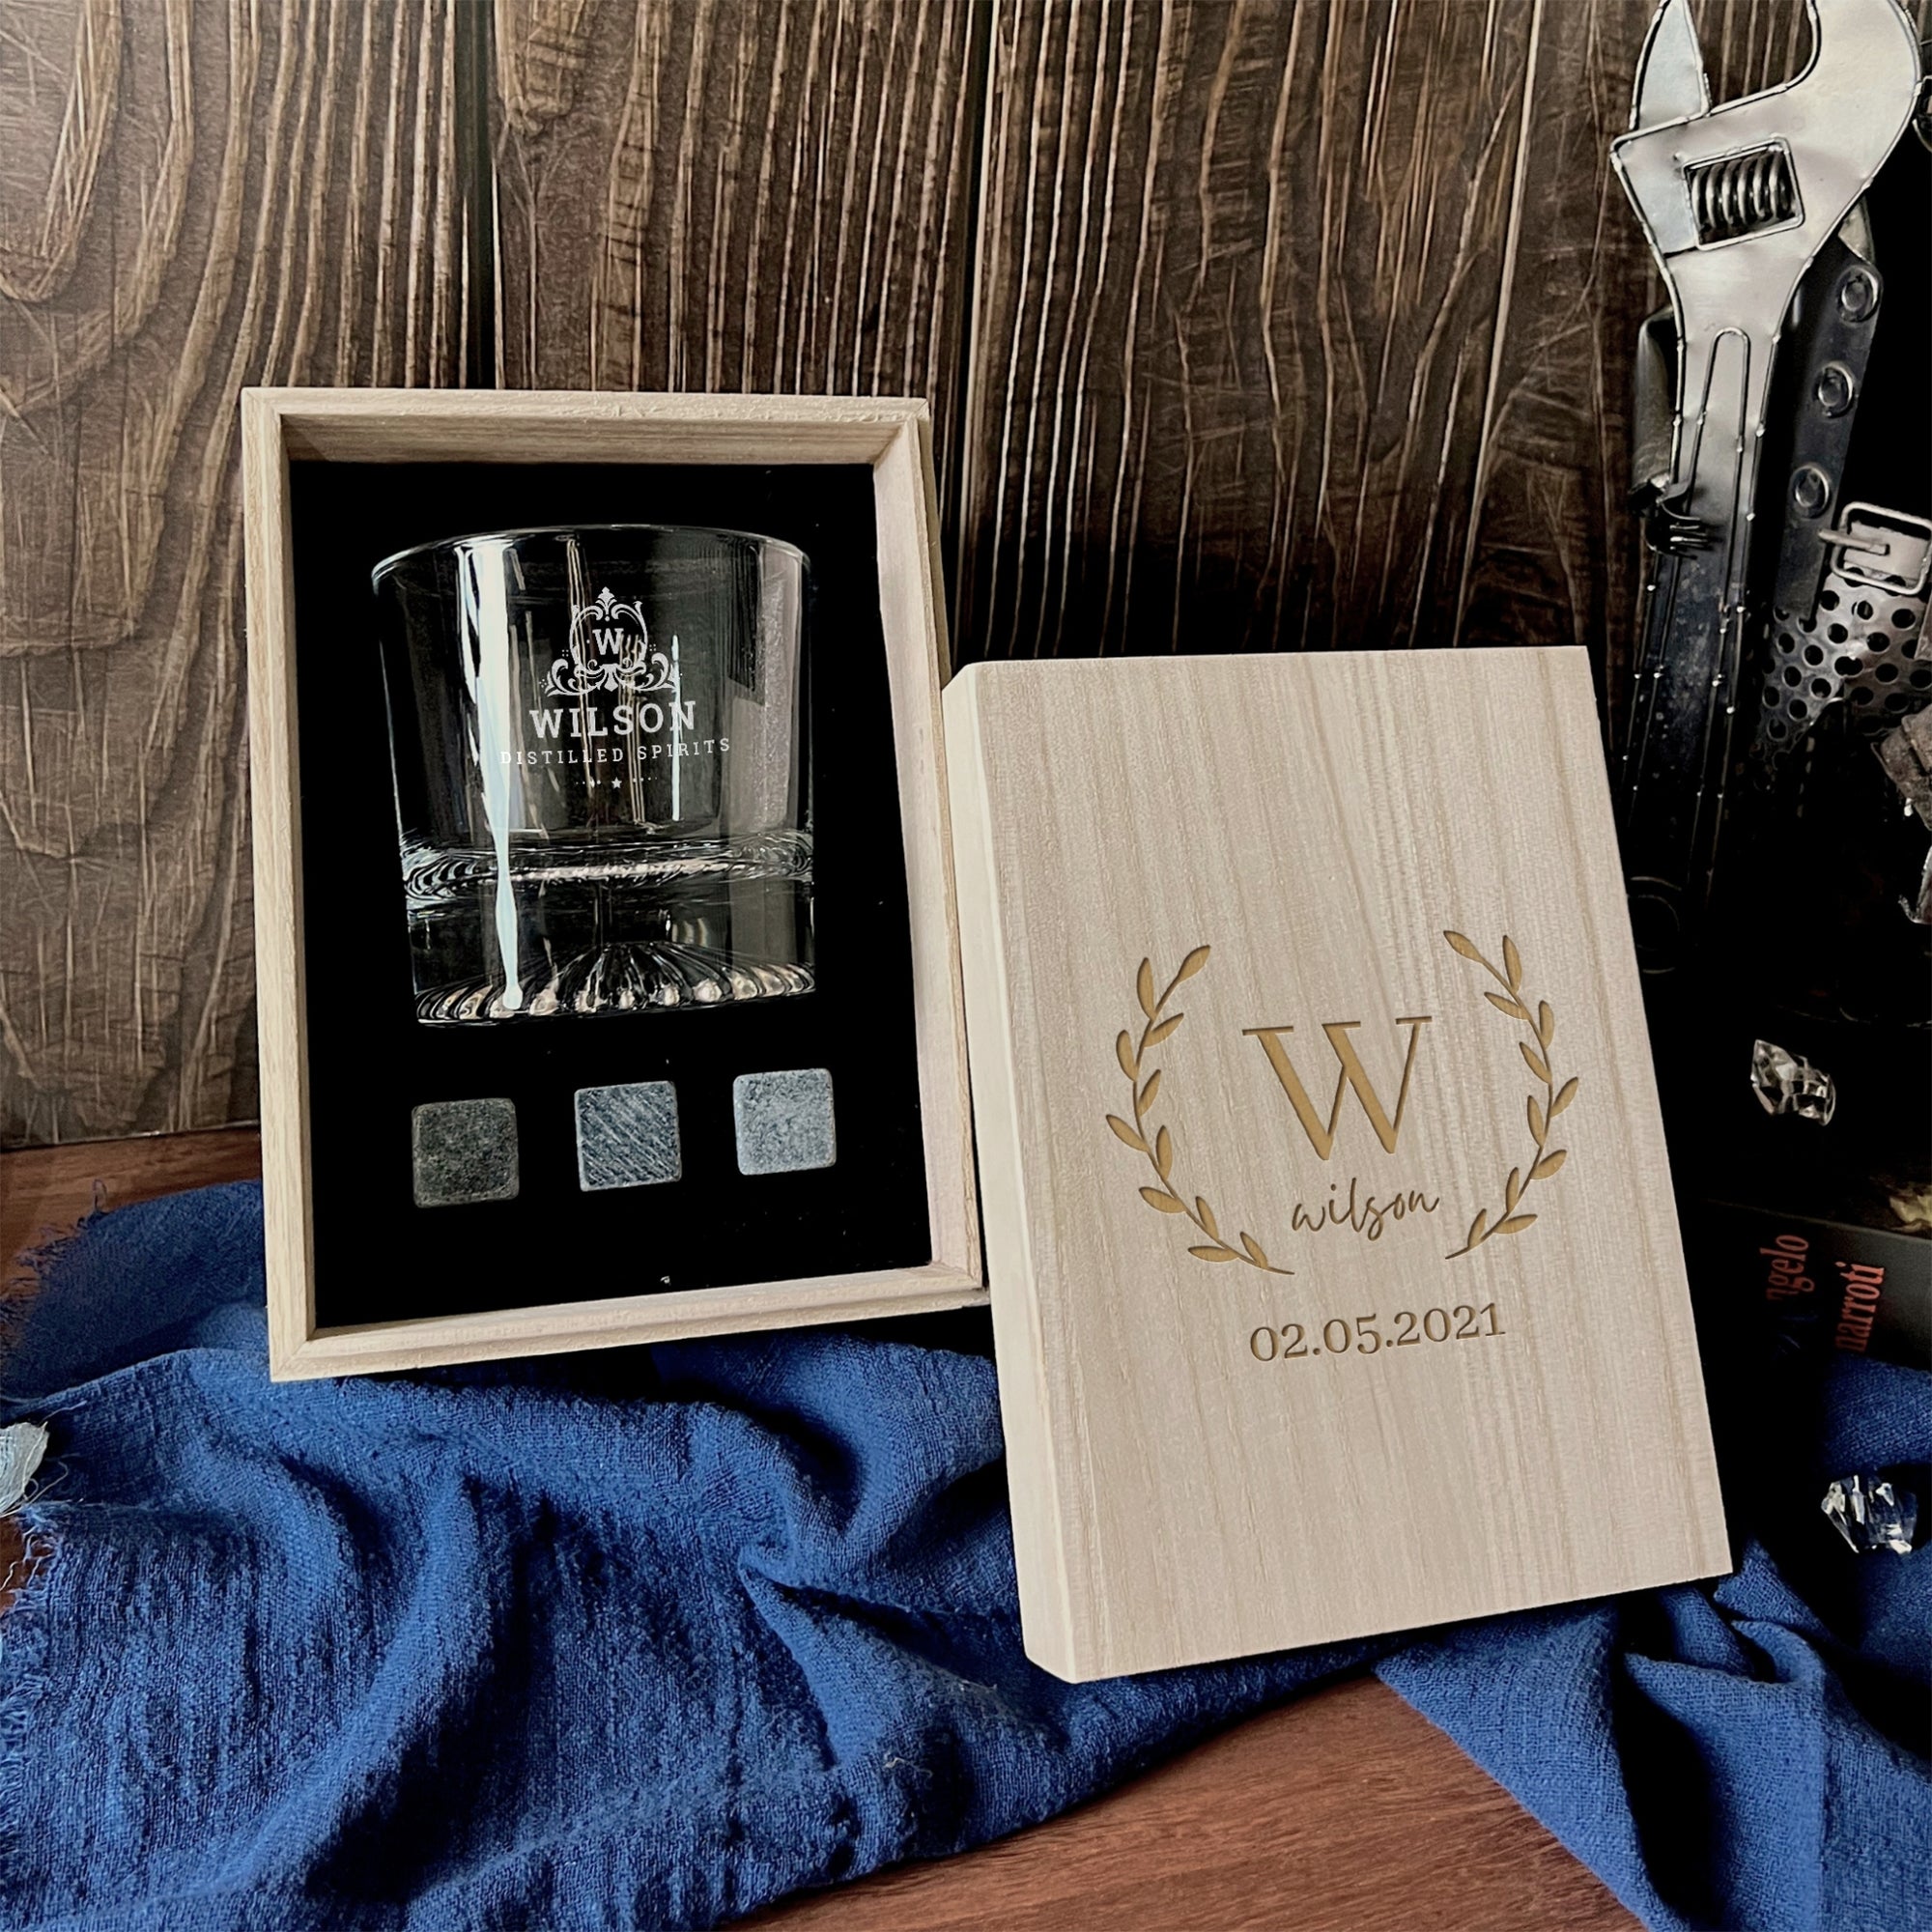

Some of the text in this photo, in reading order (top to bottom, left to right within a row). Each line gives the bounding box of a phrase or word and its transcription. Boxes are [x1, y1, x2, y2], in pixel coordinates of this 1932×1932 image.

[592, 627, 625, 655] W
[529, 700, 696, 739] WILSON
[499, 738, 730, 765] DISTILLED SPIRITS
[1241, 1015, 1433, 1161] W
[1291, 1177, 1440, 1242] wilson
[1249, 1301, 1507, 1362] 02.05.2021
